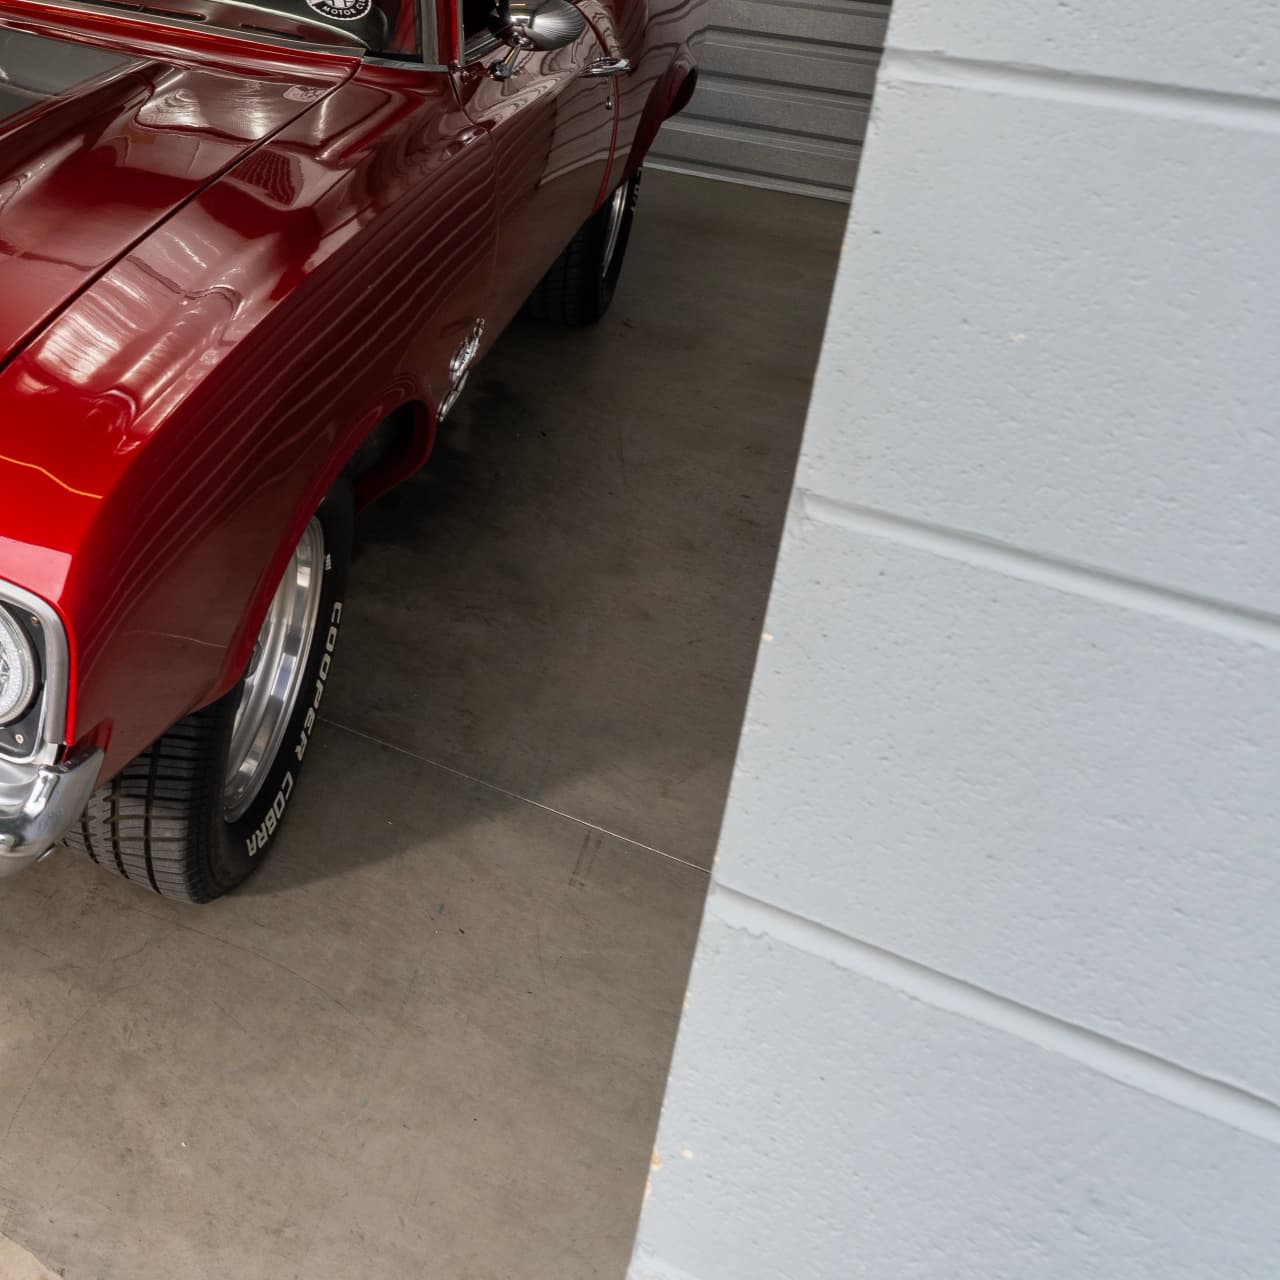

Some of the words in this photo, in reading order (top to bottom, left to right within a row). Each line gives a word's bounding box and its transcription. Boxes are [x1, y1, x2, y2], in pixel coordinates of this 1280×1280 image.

[322, 5, 357, 16] MOTOR
[295, 601, 343, 761] COOPER
[246, 771, 294, 857] COBRA
